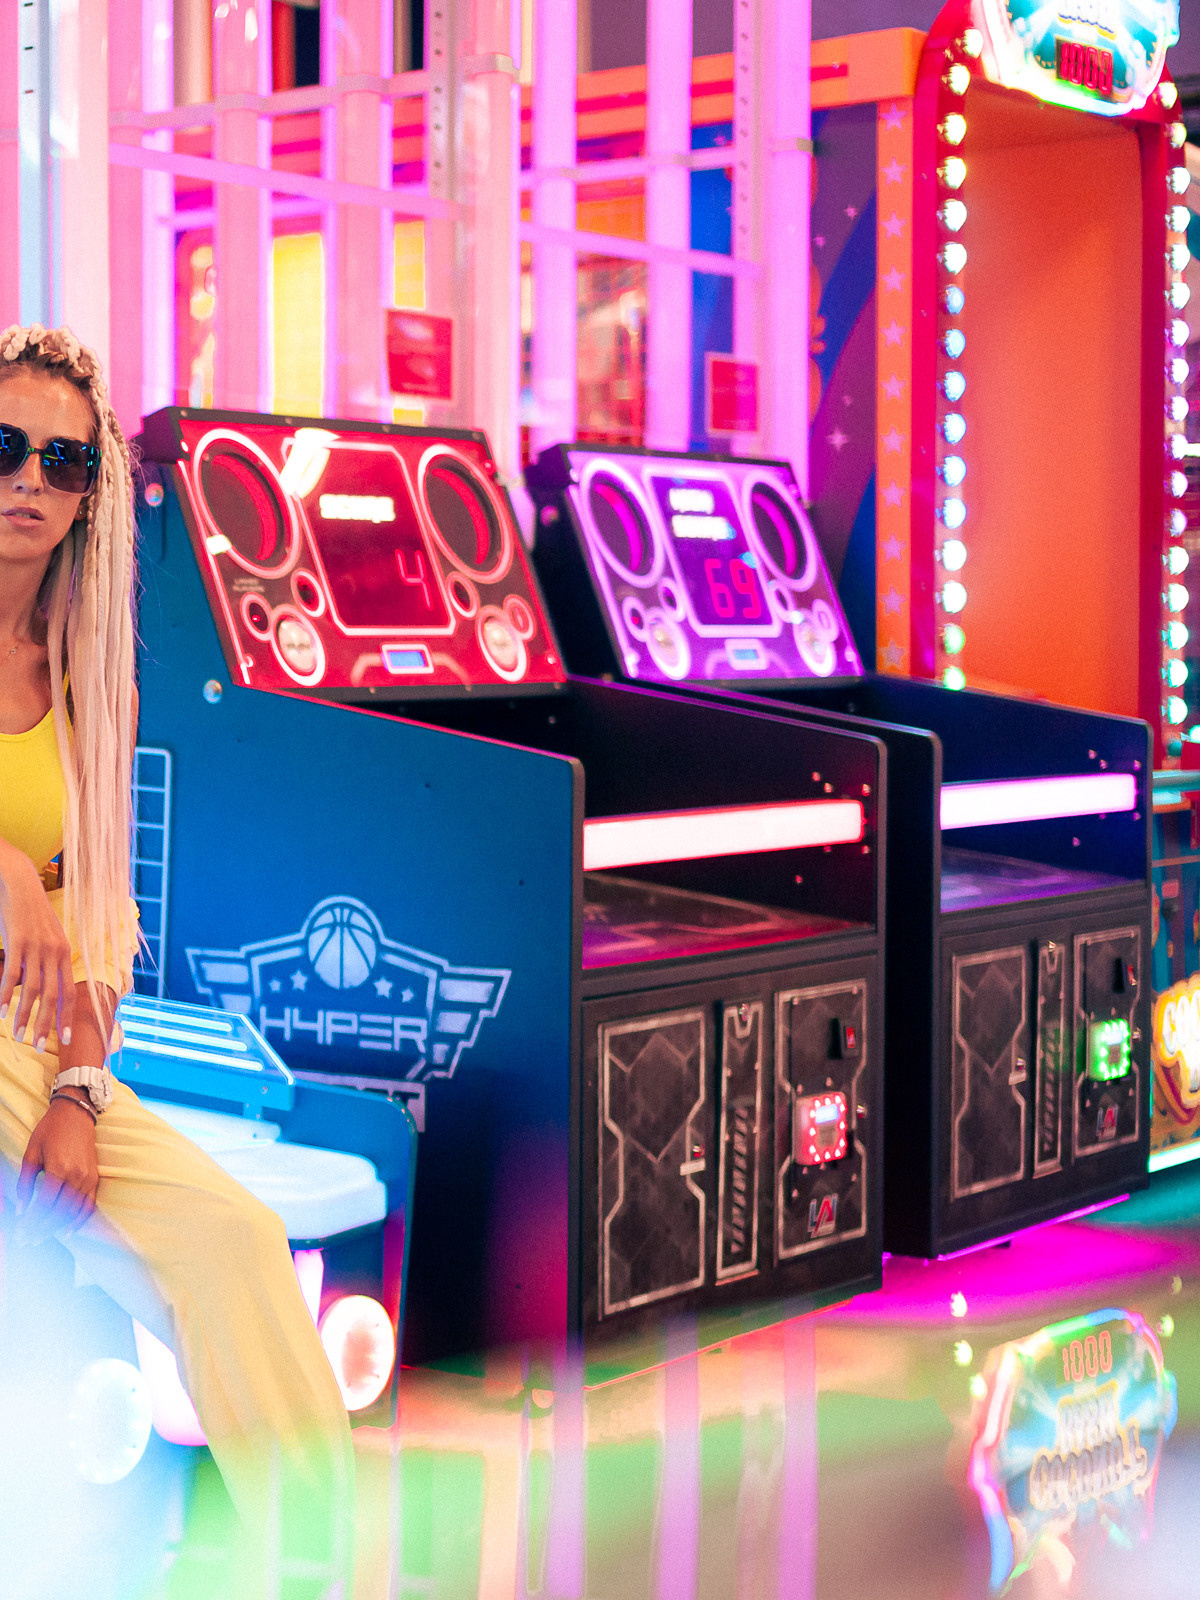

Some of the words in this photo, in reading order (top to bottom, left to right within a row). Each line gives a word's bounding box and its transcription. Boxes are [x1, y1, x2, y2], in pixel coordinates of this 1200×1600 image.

[1060, 41, 1113, 95] 1000
[395, 548, 434, 611] 4
[704, 558, 762, 618] 69
[259, 1005, 428, 1054] HYPER
